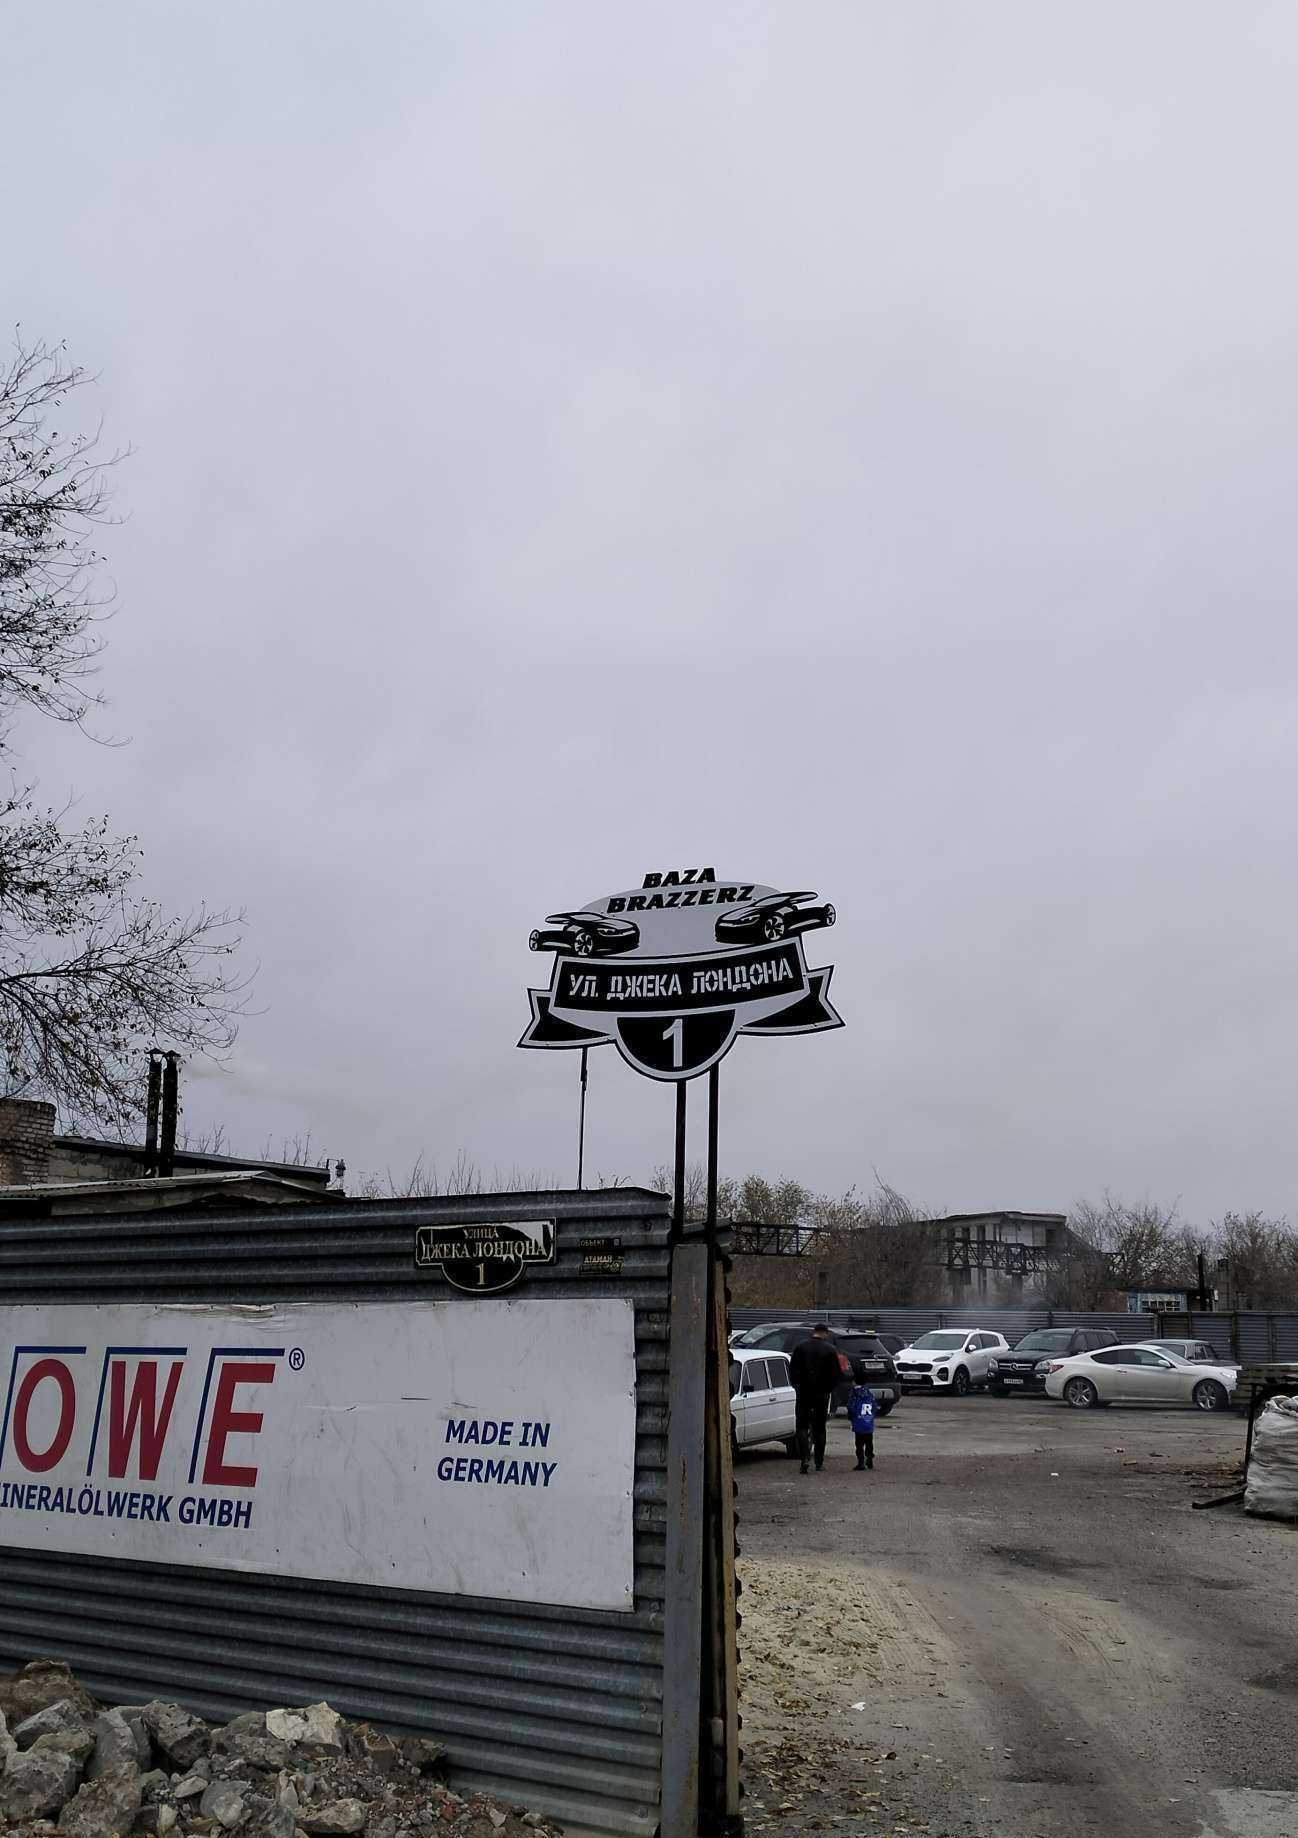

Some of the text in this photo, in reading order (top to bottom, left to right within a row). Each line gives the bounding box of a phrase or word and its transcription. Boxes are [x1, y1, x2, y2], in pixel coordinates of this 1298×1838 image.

[642, 867, 717, 889] BAZA
[606, 885, 755, 914] BRAZZERZ
[568, 958, 794, 1000] УЛ. ДЖЕКА ЛОНДОНА
[662, 1018, 684, 1068] 1
[463, 1226, 499, 1239] УЛИЦА
[420, 1236, 544, 1263] ДЖЕКА ЛОНДОНА
[475, 1263, 486, 1285] 1
[445, 1419, 551, 1448] MADE IN
[437, 1457, 557, 1487] GERMANY
[0, 1482, 253, 1529] INERALÖLWERK GMBH
